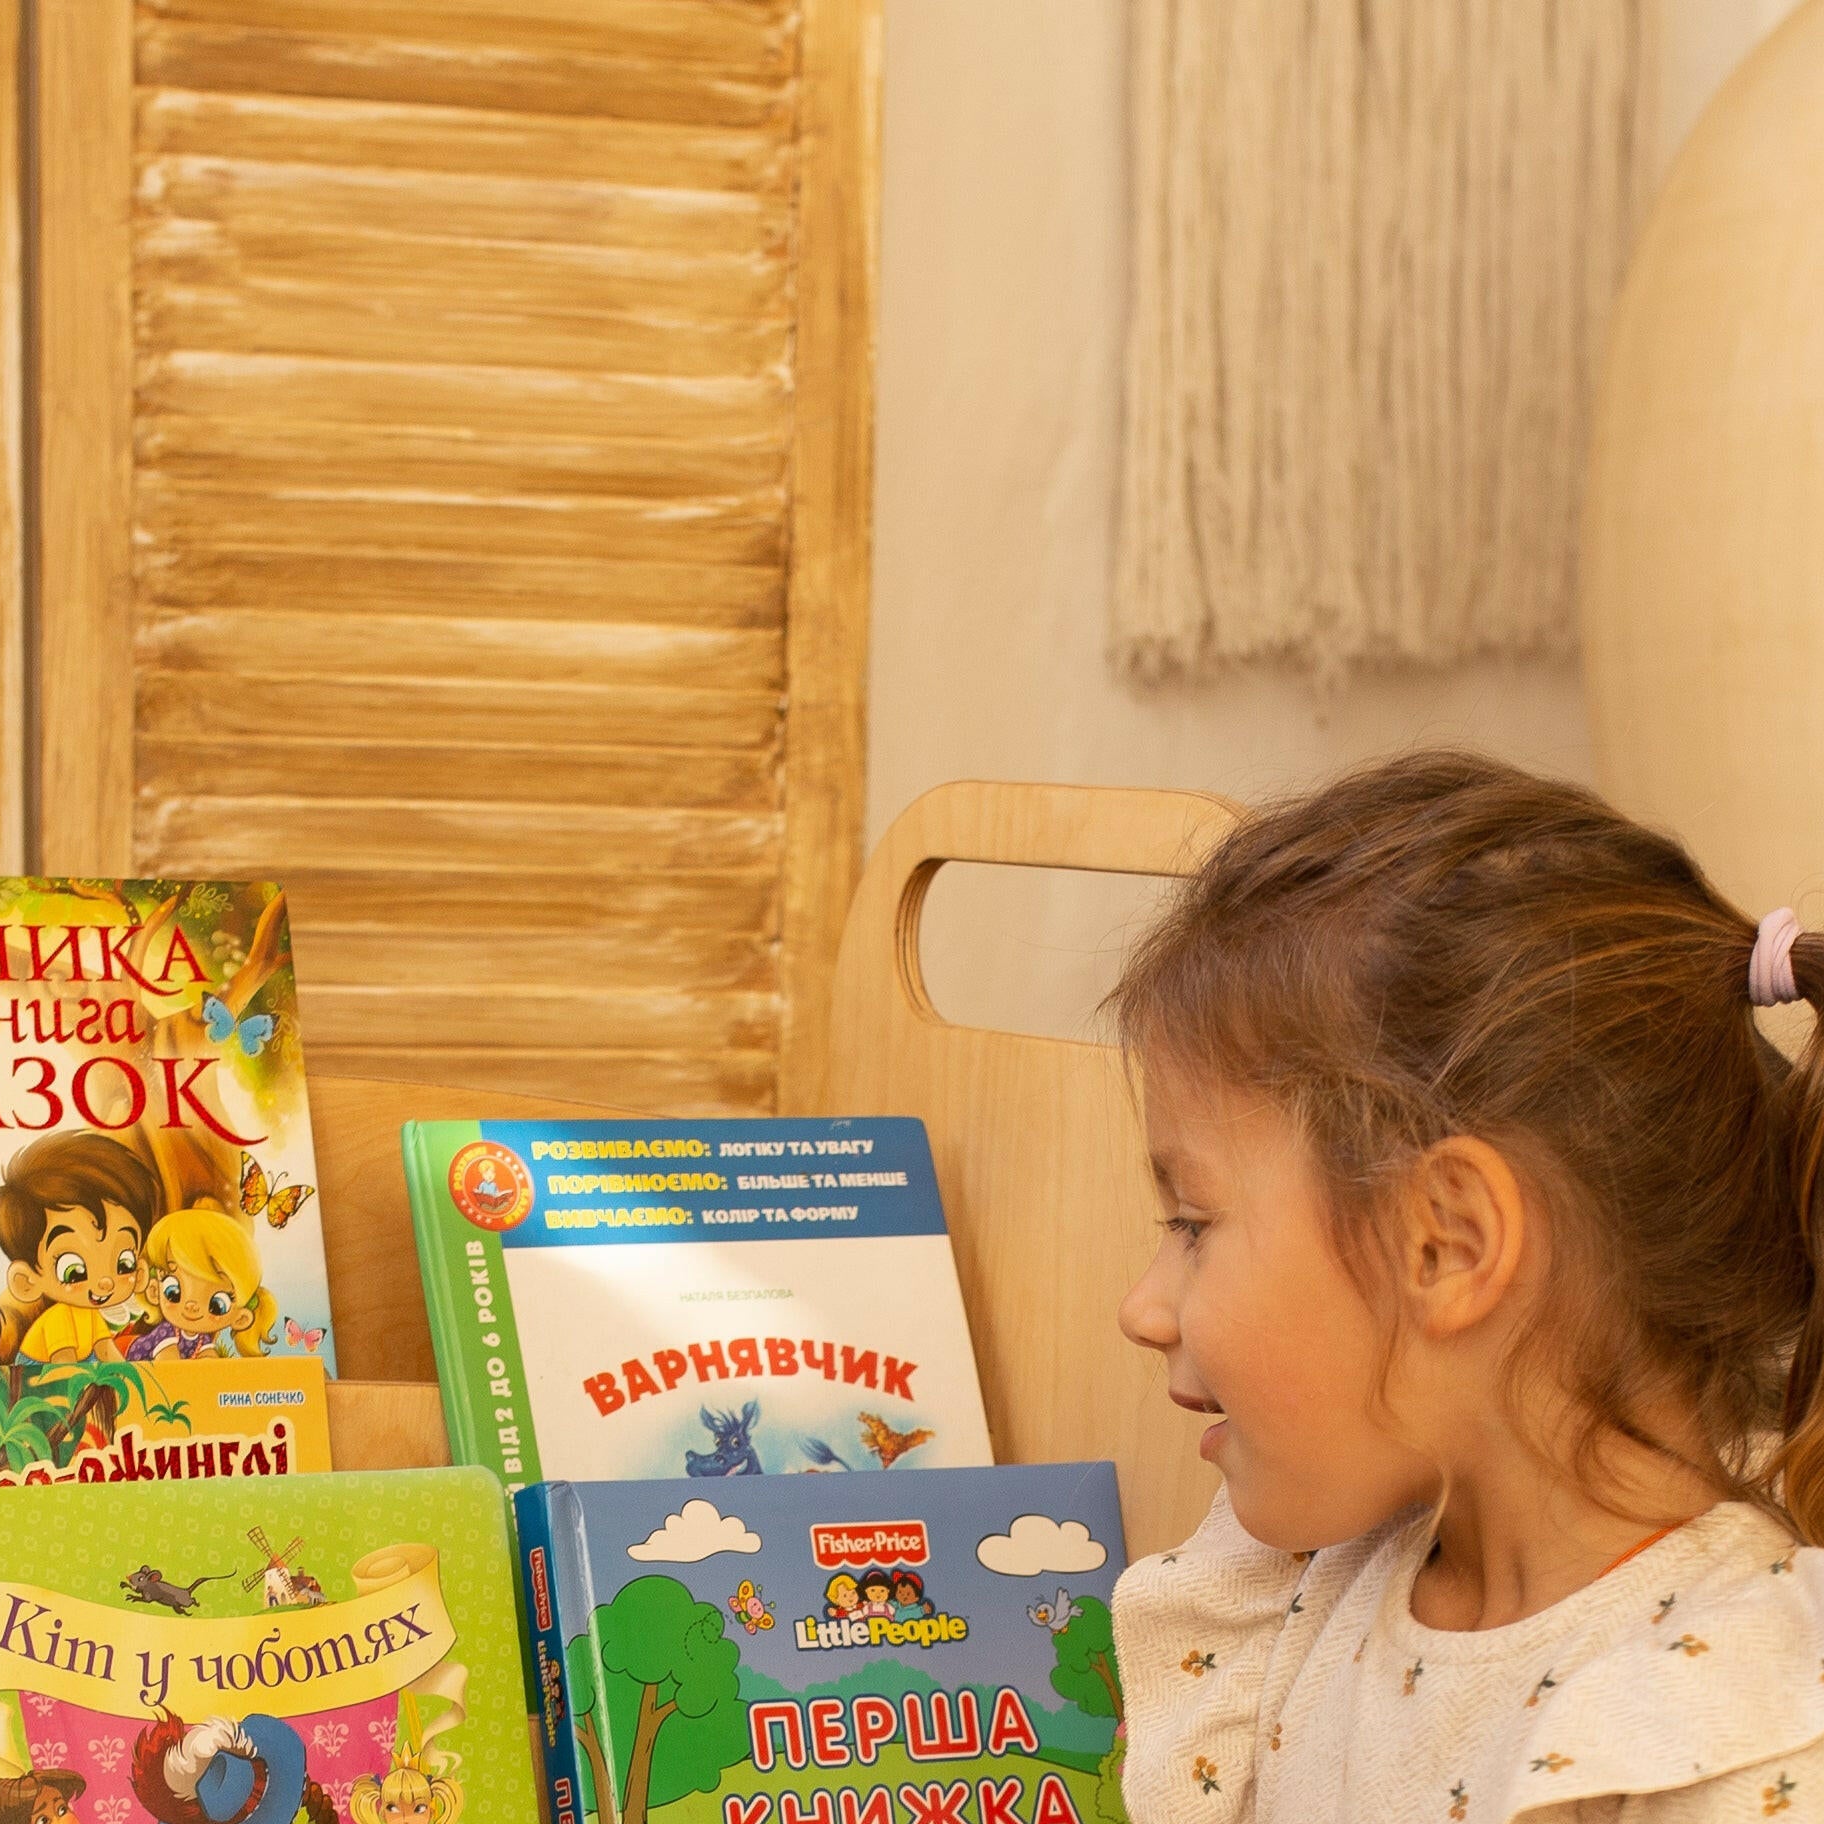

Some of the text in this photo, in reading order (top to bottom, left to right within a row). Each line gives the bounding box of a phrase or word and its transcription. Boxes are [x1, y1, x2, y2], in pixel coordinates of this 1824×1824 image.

[531, 1139, 874, 1160] РОЗВИВАЄМО: ЛОГІКУ ТА УВАГУ
[547, 1172, 908, 1194] ПОРІВНЮЄМО: БІЛЬШЕ ТА МЕНШЕ
[545, 1206, 858, 1229] ВИВЧАЄМО: КОЛІР ТА ФОРМУ
[465, 1240, 496, 1323] РОКІВ
[482, 1332, 501, 1347] 6
[487, 1357, 512, 1397] ДО
[583, 1336, 919, 1417] ВАРНЯВЧИК
[218, 1390, 305, 1406] ІРИНА СОНЕЧКО
[495, 1407, 514, 1422] 2
[498, 1425, 523, 1473] ВІД
[137, 1648, 176, 1706] у
[190, 1603, 433, 1692] чоботях
[746, 1686, 1040, 1772] ПЕРША
